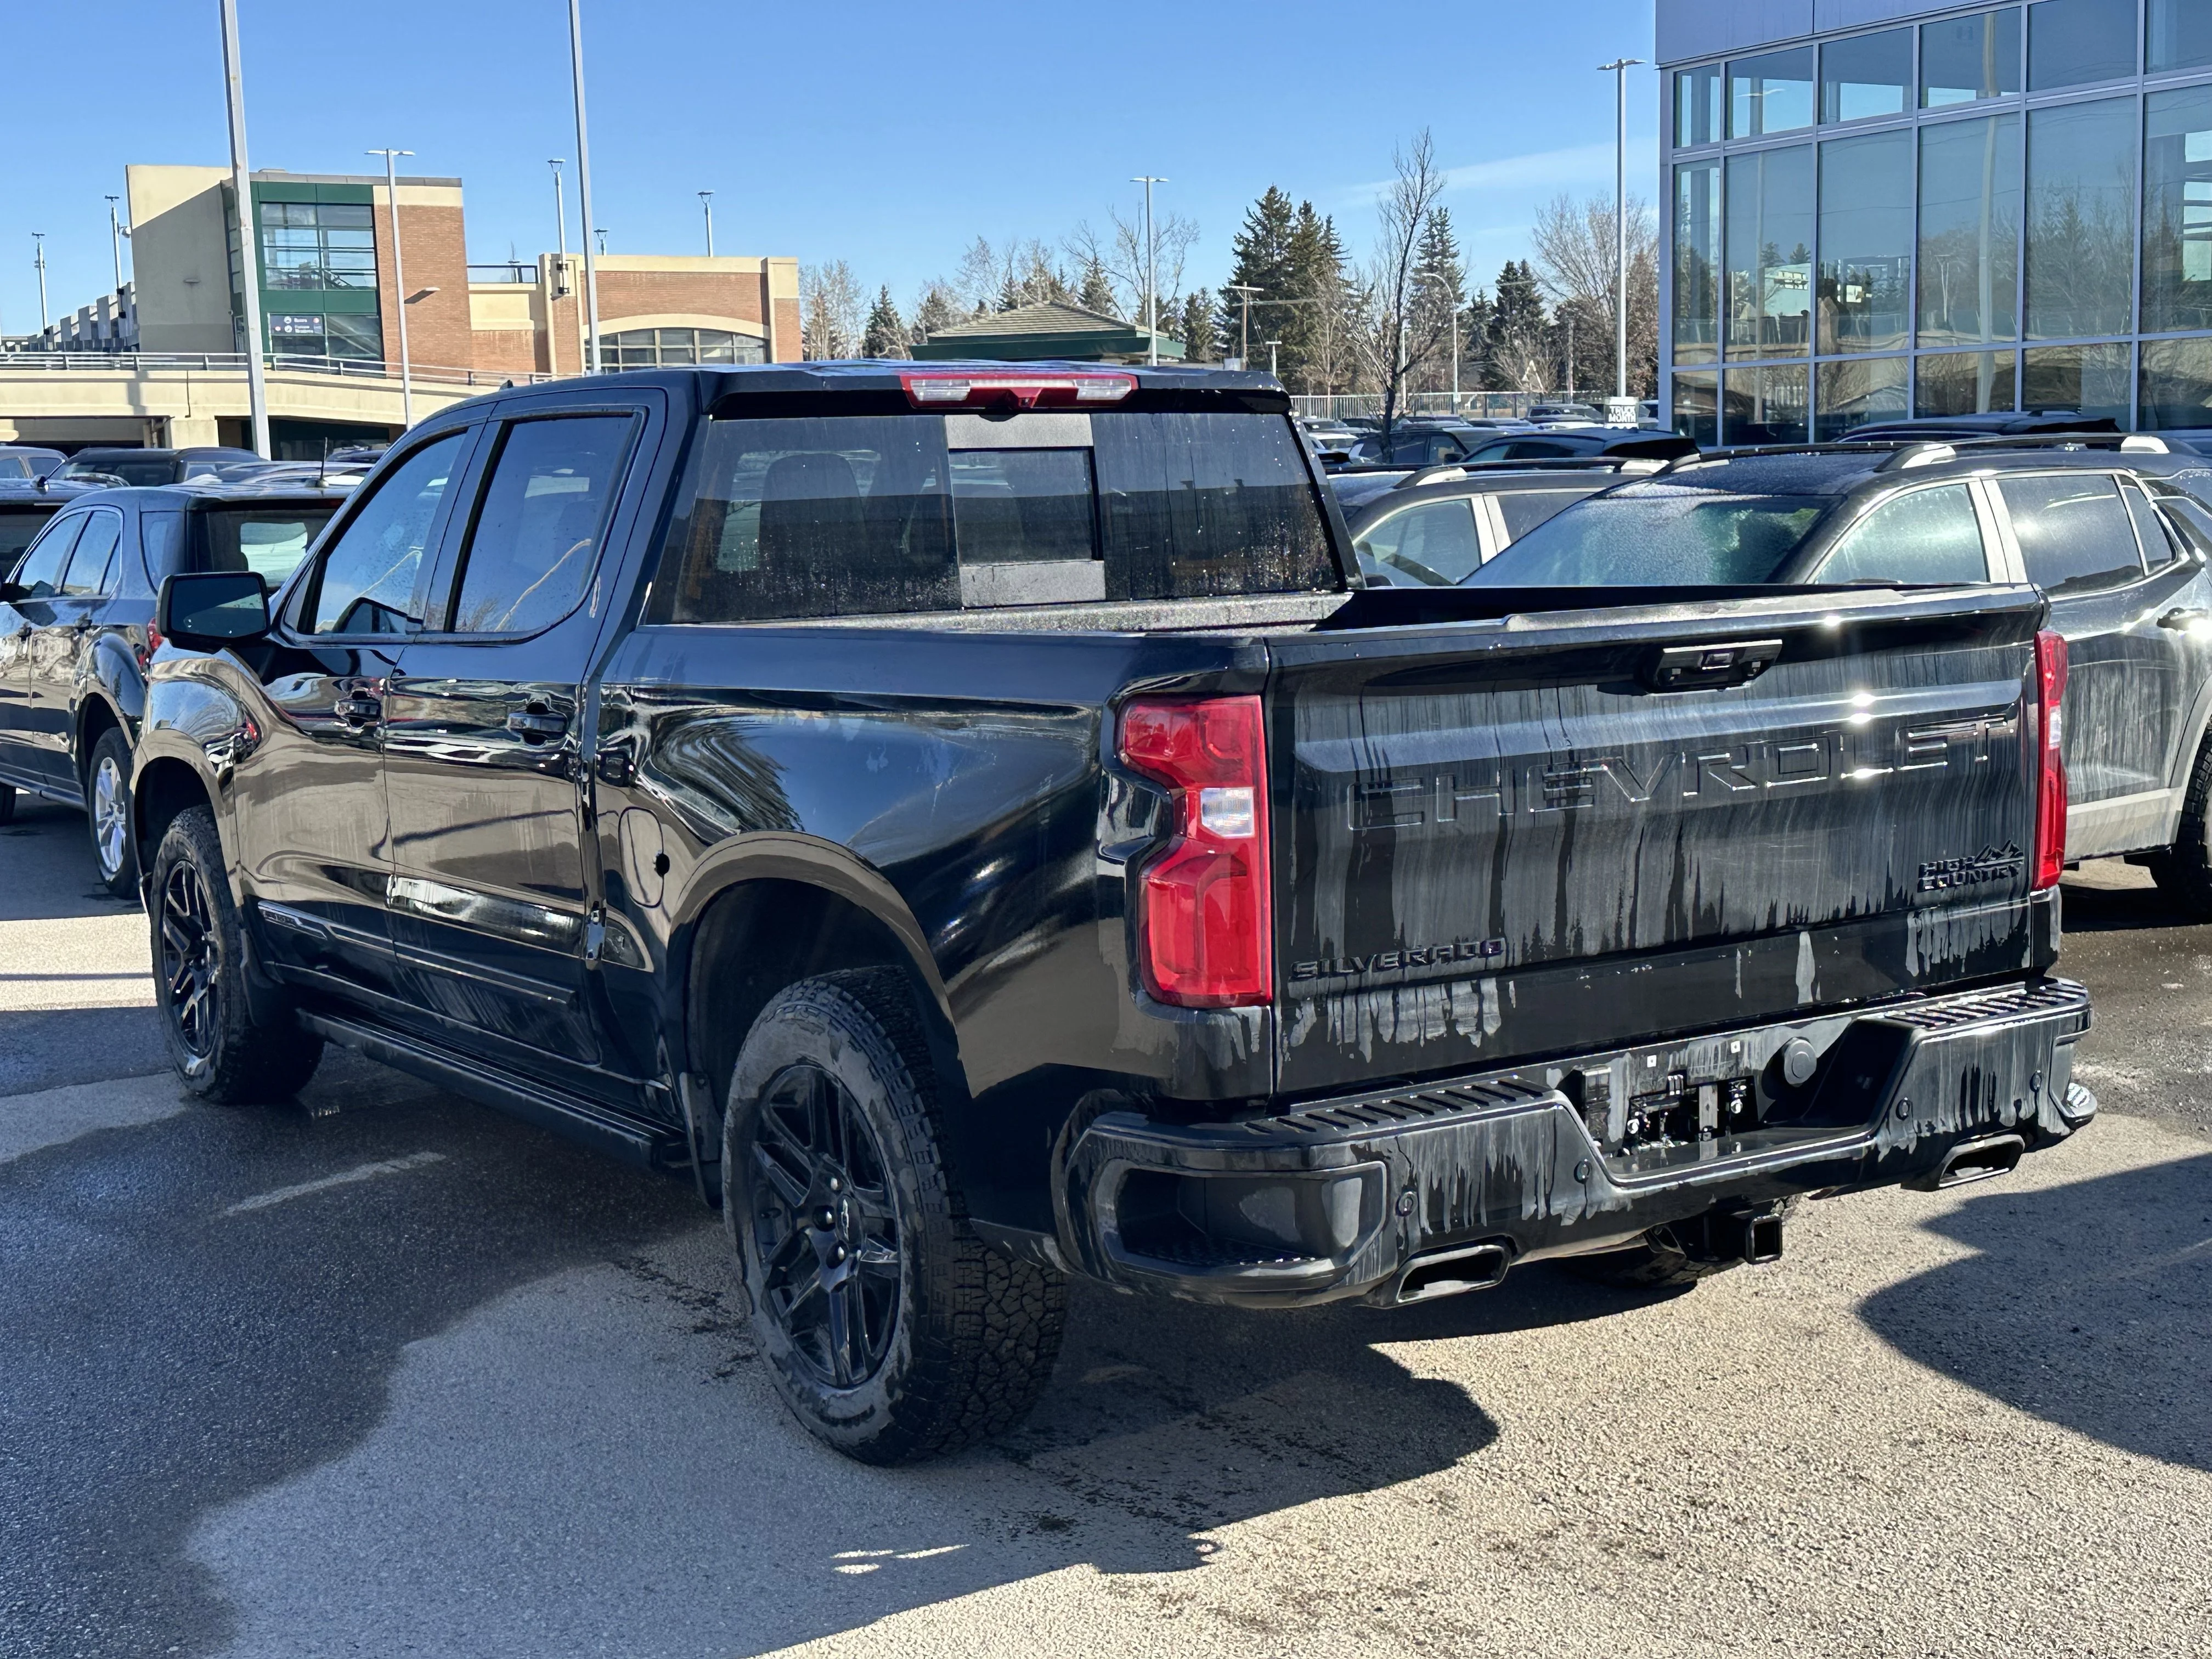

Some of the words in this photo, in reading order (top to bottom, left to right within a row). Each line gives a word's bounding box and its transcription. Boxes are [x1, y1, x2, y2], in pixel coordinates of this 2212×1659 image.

[1609, 405, 1635, 414] TRUCK
[1609, 413, 1636, 422] MONTH
[1347, 713, 2008, 831] CHEVROLET
[1917, 862, 2024, 893] COUNTRY
[1918, 856, 1976, 878] HIGH
[1289, 937, 1506, 979] SILVERADO
